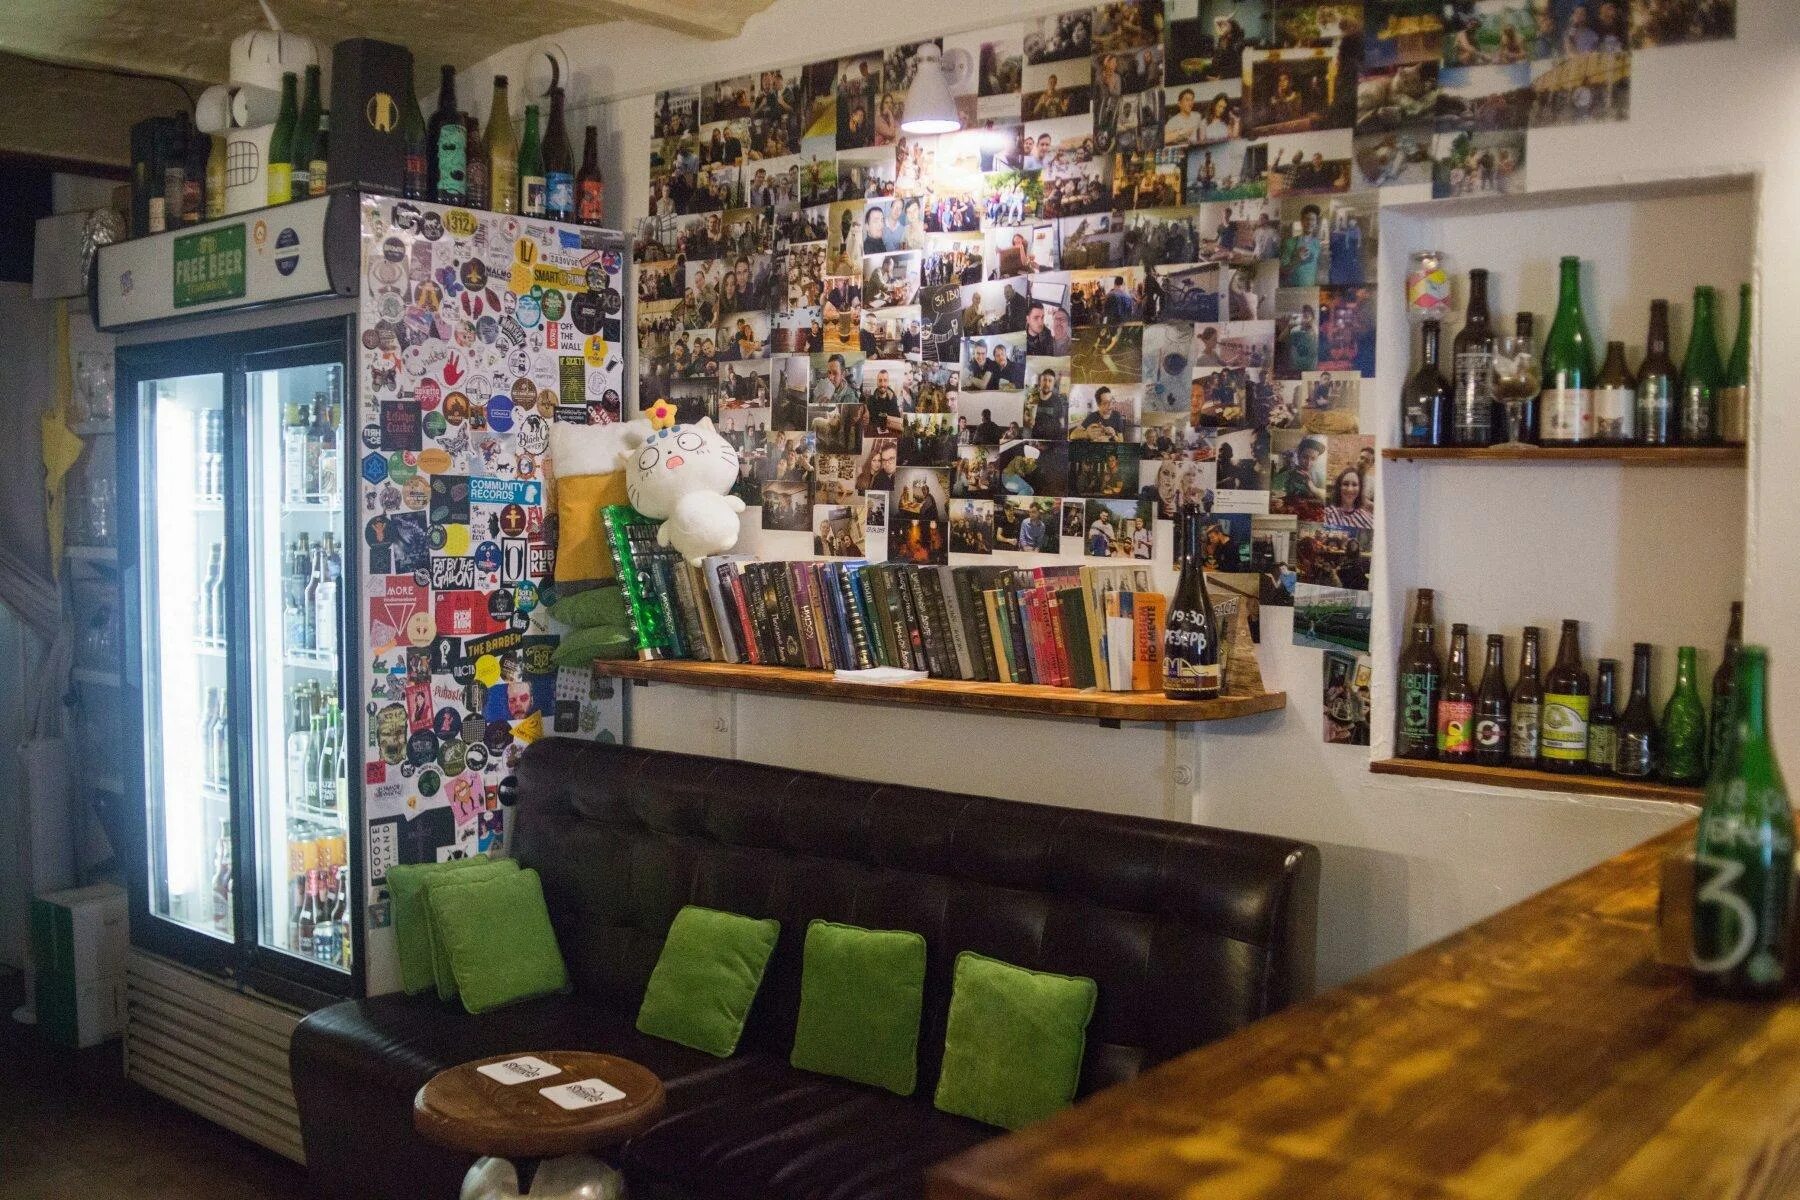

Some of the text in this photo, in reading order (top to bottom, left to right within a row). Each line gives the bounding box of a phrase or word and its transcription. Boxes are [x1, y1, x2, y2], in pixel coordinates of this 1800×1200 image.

[451, 215, 469, 232] 312
[176, 249, 242, 284] FREE BEER
[534, 269, 559, 283] SMART
[560, 322, 573, 330] OFF
[560, 332, 574, 340] THE
[560, 342, 582, 351] WALL
[517, 431, 541, 448] Black
[470, 479, 524, 491] COMMUNITY
[470, 489, 514, 500] RECORDS
[530, 549, 555, 561] DUB
[433, 557, 475, 573] FAT BY THE
[530, 560, 555, 572] KEY
[387, 586, 414, 595] MORE
[1171, 609, 1205, 626] 19:30
[1140, 605, 1148, 662] РЕКВИЕМ
[468, 642, 485, 656] THE
[372, 827, 381, 877] GOOSE
[383, 825, 391, 869] SLAND
